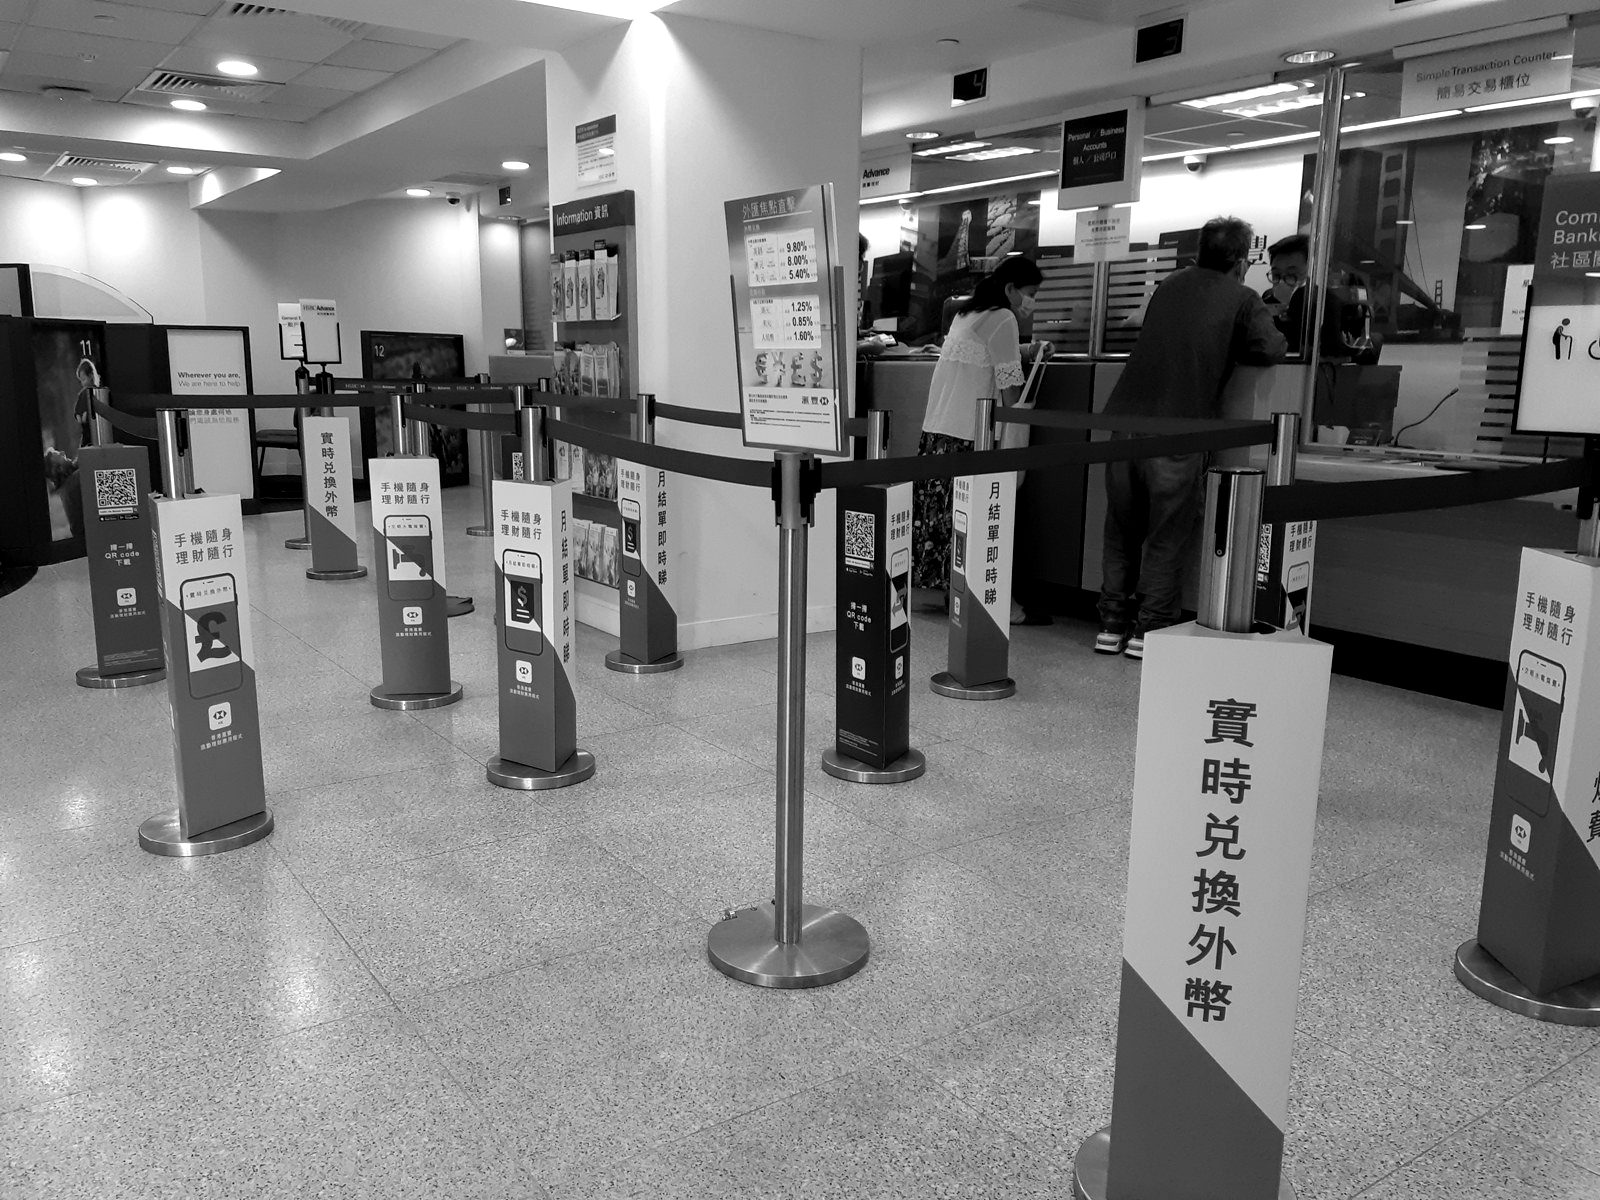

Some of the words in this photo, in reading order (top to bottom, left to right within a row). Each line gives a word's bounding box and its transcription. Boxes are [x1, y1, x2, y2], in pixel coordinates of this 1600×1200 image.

[1452, 58, 1511, 76] Transaction
[1513, 50, 1558, 65] Counter
[1437, 73, 1531, 101] 簡易交易櫃位
[1083, 142, 1108, 151] Accounts
[862, 168, 891, 180] Advance
[556, 209, 593, 227] Information
[594, 203, 609, 220] 資訊
[1555, 210, 1600, 225] Com
[1553, 228, 1600, 245] Bank
[786, 241, 808, 253] 9.80%
[787, 254, 809, 267] 8.00%
[789, 266, 811, 280] 5.40%
[791, 301, 812, 312] 1.25%
[792, 316, 813, 327] 0.85%
[794, 331, 814, 342] 1.60%
[80, 340, 92, 356] 11
[375, 345, 385, 358] 12
[214, 373, 227, 382] you
[321, 432, 338, 518] 實時兌換外幣
[381, 482, 430, 493] 手機隨身
[381, 494, 430, 505] 理財隨行
[501, 509, 542, 526] 手機隨身
[501, 524, 542, 541] 理財隨行
[657, 470, 668, 586] 月結單即時睇
[174, 528, 233, 548] 手機隨身
[985, 481, 1001, 606] 月結單即時睇
[104, 552, 118, 560] QR
[176, 544, 234, 566] 理財隨行
[1525, 591, 1576, 624] 手機隨身
[846, 610, 856, 619] QR
[857, 614, 872, 624] code
[1522, 612, 1574, 646] 理財隨行
[1184, 698, 1258, 1022] 實時兌換外幣
